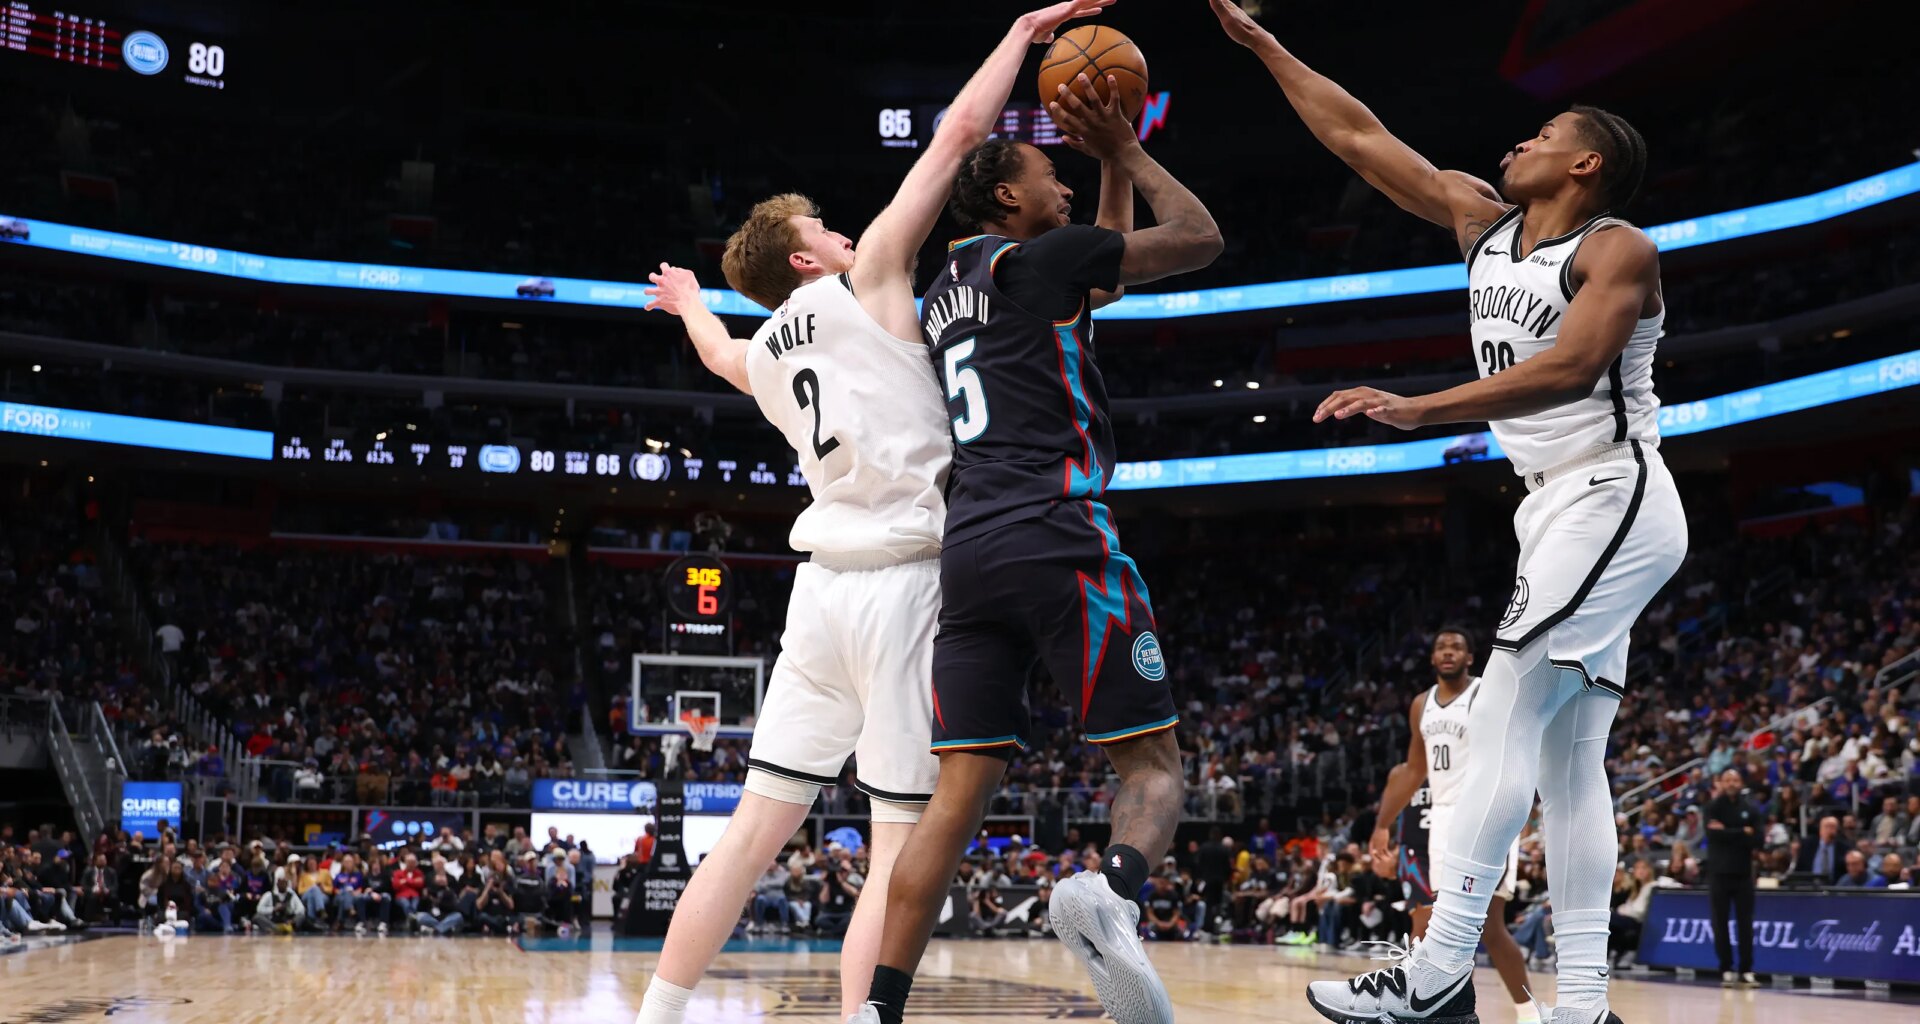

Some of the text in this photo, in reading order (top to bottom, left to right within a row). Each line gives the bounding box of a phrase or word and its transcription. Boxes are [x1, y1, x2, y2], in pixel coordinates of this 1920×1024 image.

[188, 42, 225, 77] 80
[879, 108, 912, 138] 65
[359, 269, 400, 285] FORD
[925, 285, 989, 347] HOLLAND II
[1470, 286, 1561, 339] ROOKLYN
[765, 313, 816, 361] WOLF
[1879, 358, 1920, 386] FOR
[944, 335, 990, 445] 5
[3, 408, 60, 431] FORD
[792, 368, 841, 462] 2
[530, 450, 555, 473] 80
[596, 454, 620, 475] 65
[1117, 461, 1163, 481] 289
[1327, 451, 1377, 470] FORD
[697, 585, 718, 615] 6
[685, 623, 725, 635] TISSOT
[1432, 744, 1450, 771] 20
[552, 781, 629, 803] CURE
[683, 783, 744, 799] URTSID
[122, 798, 167, 811] CURE
[645, 890, 677, 900] FORD
[645, 901, 676, 911] HEAL
[1662, 917, 1799, 949] LUNUL
[1804, 919, 1884, 964] Tequila
